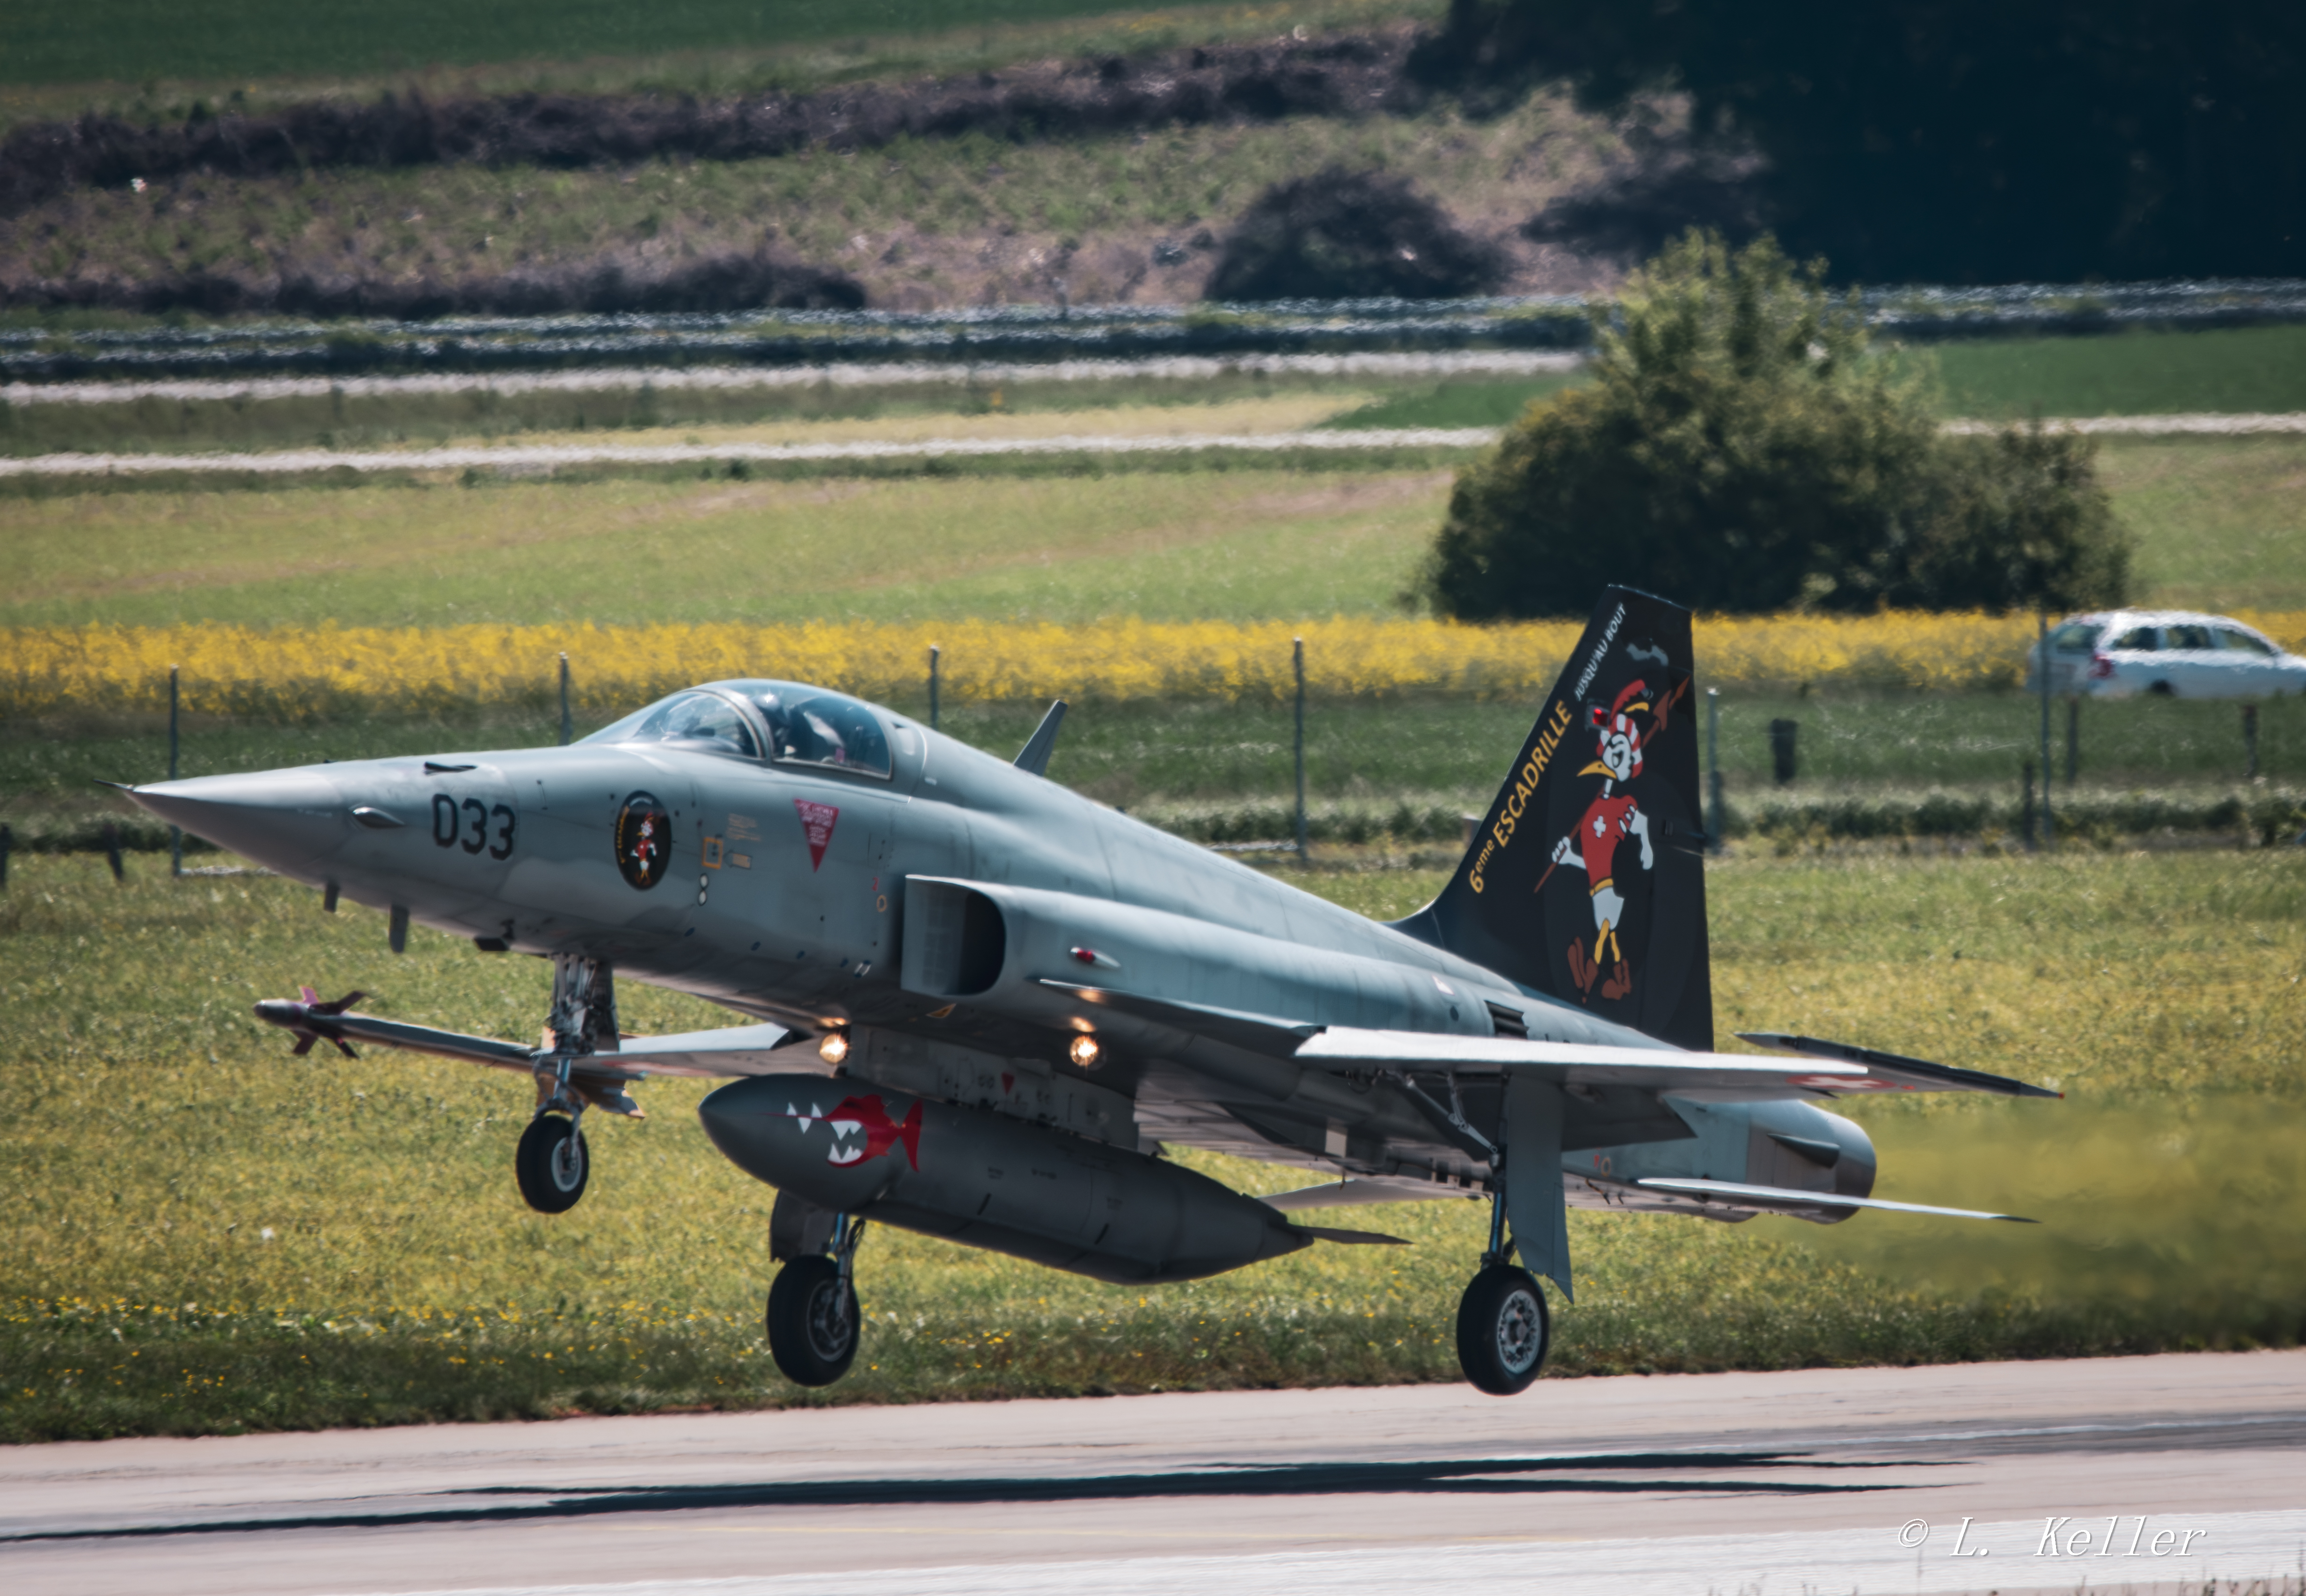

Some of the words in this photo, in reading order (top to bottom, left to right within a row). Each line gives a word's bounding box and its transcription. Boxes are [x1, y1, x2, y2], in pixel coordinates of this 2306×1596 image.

[1604, 601, 1626, 642] BOUT
[1492, 700, 1573, 848] ESCADRILLE
[432, 793, 516, 861] 033
